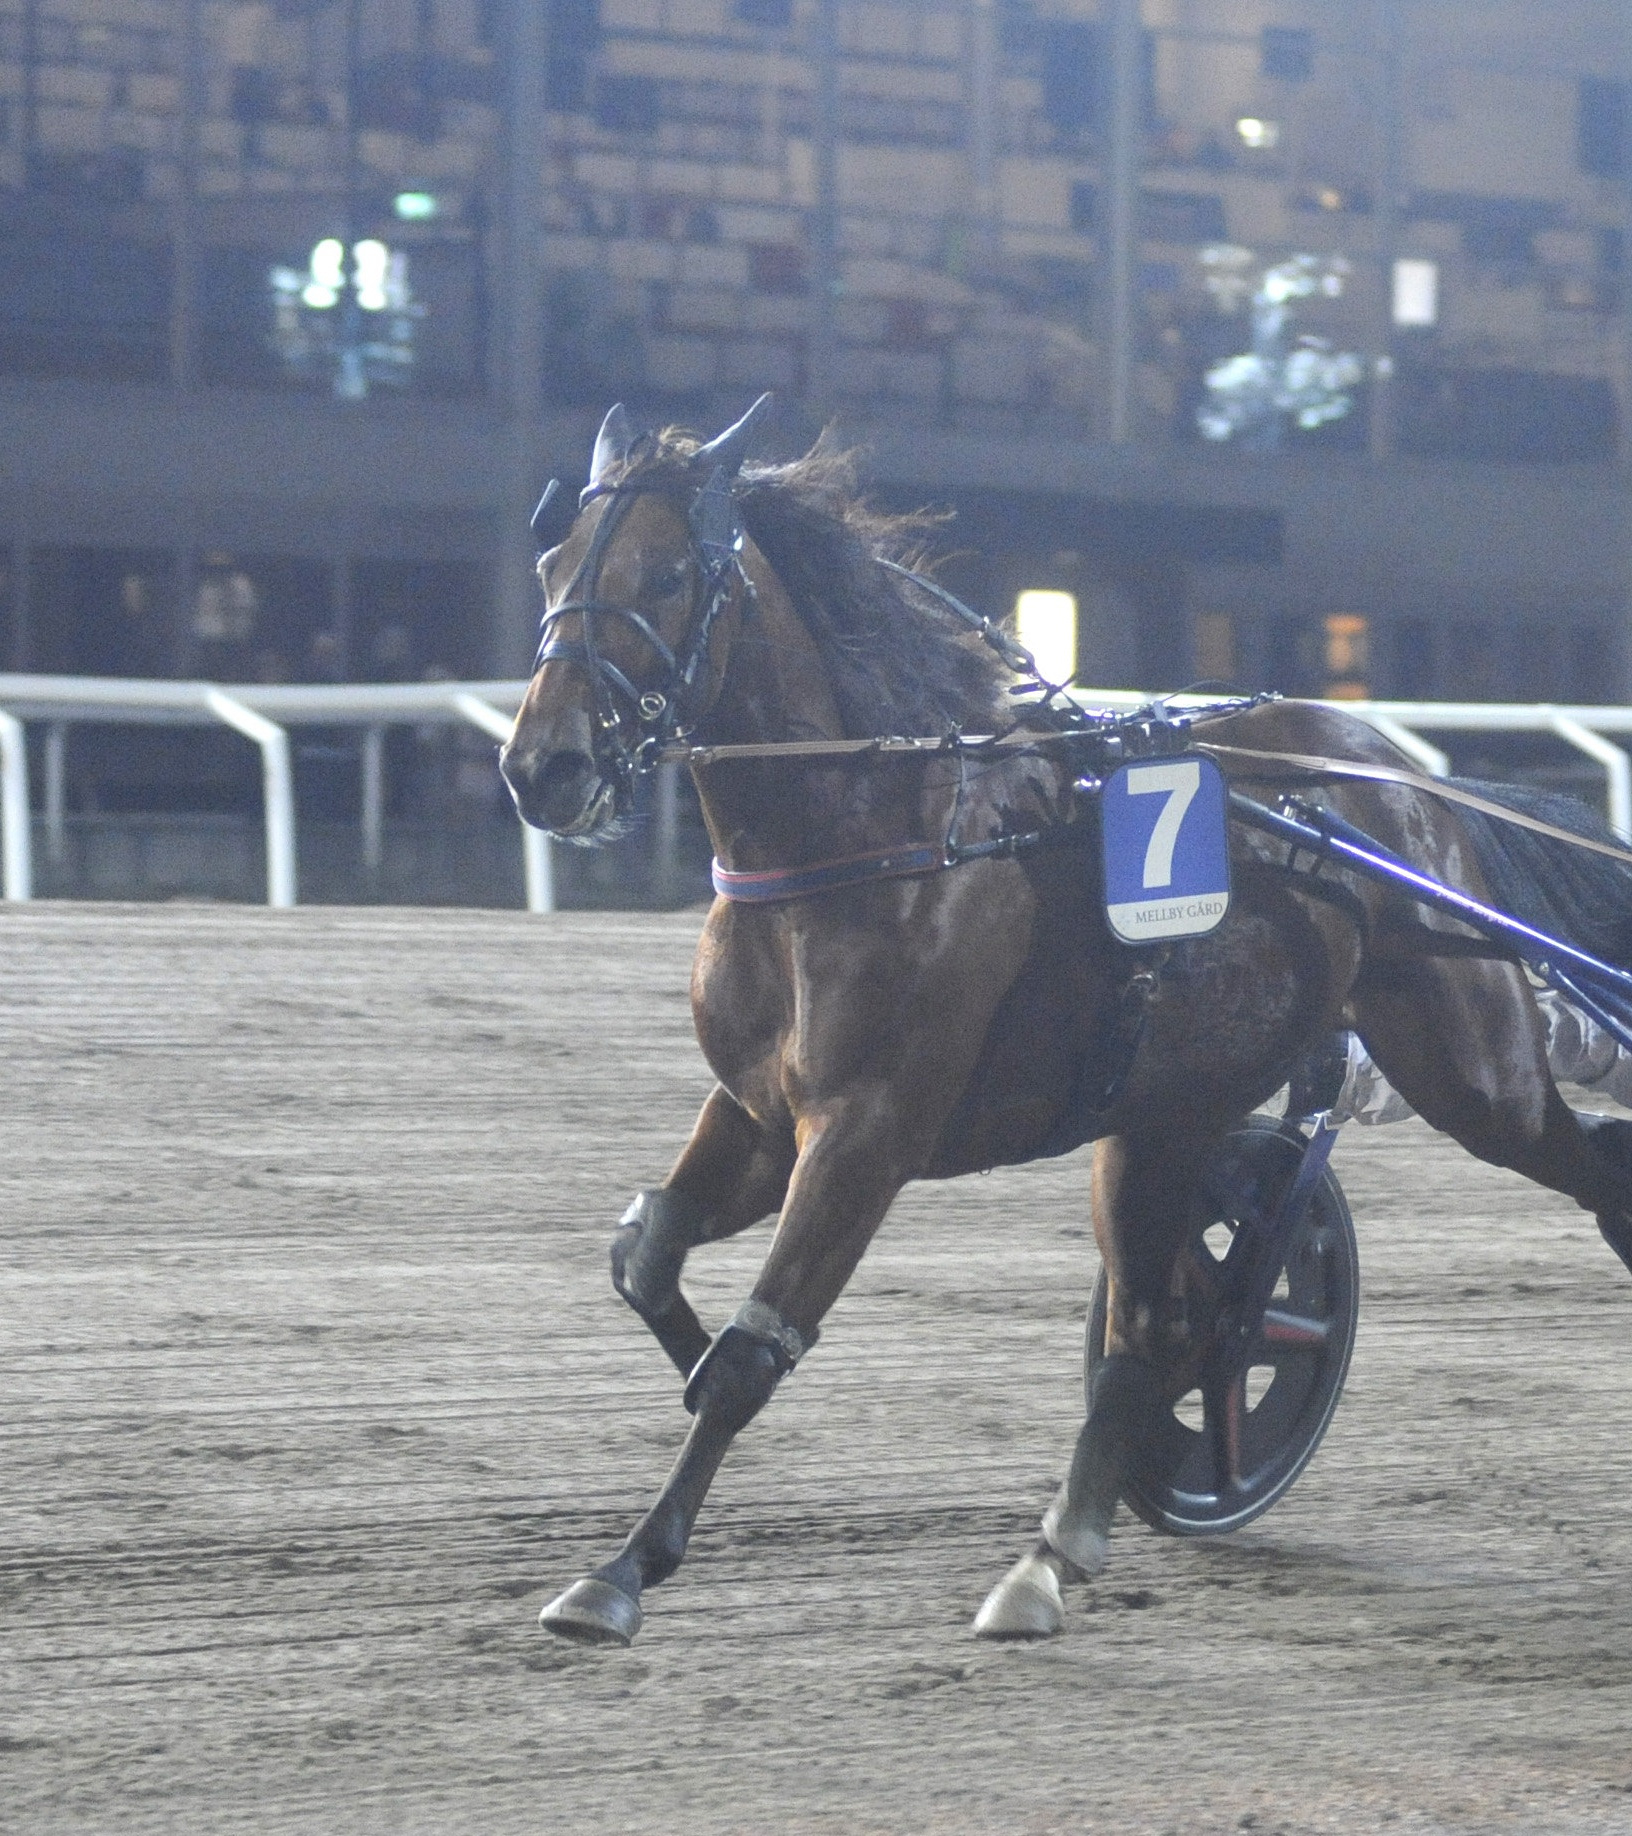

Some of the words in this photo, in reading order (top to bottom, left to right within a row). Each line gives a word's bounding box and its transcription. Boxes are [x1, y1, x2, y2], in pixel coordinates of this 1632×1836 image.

[1127, 762, 1200, 888] 7
[1136, 907, 1184, 924] MELLBY
[1187, 901, 1223, 918] GÅRD
